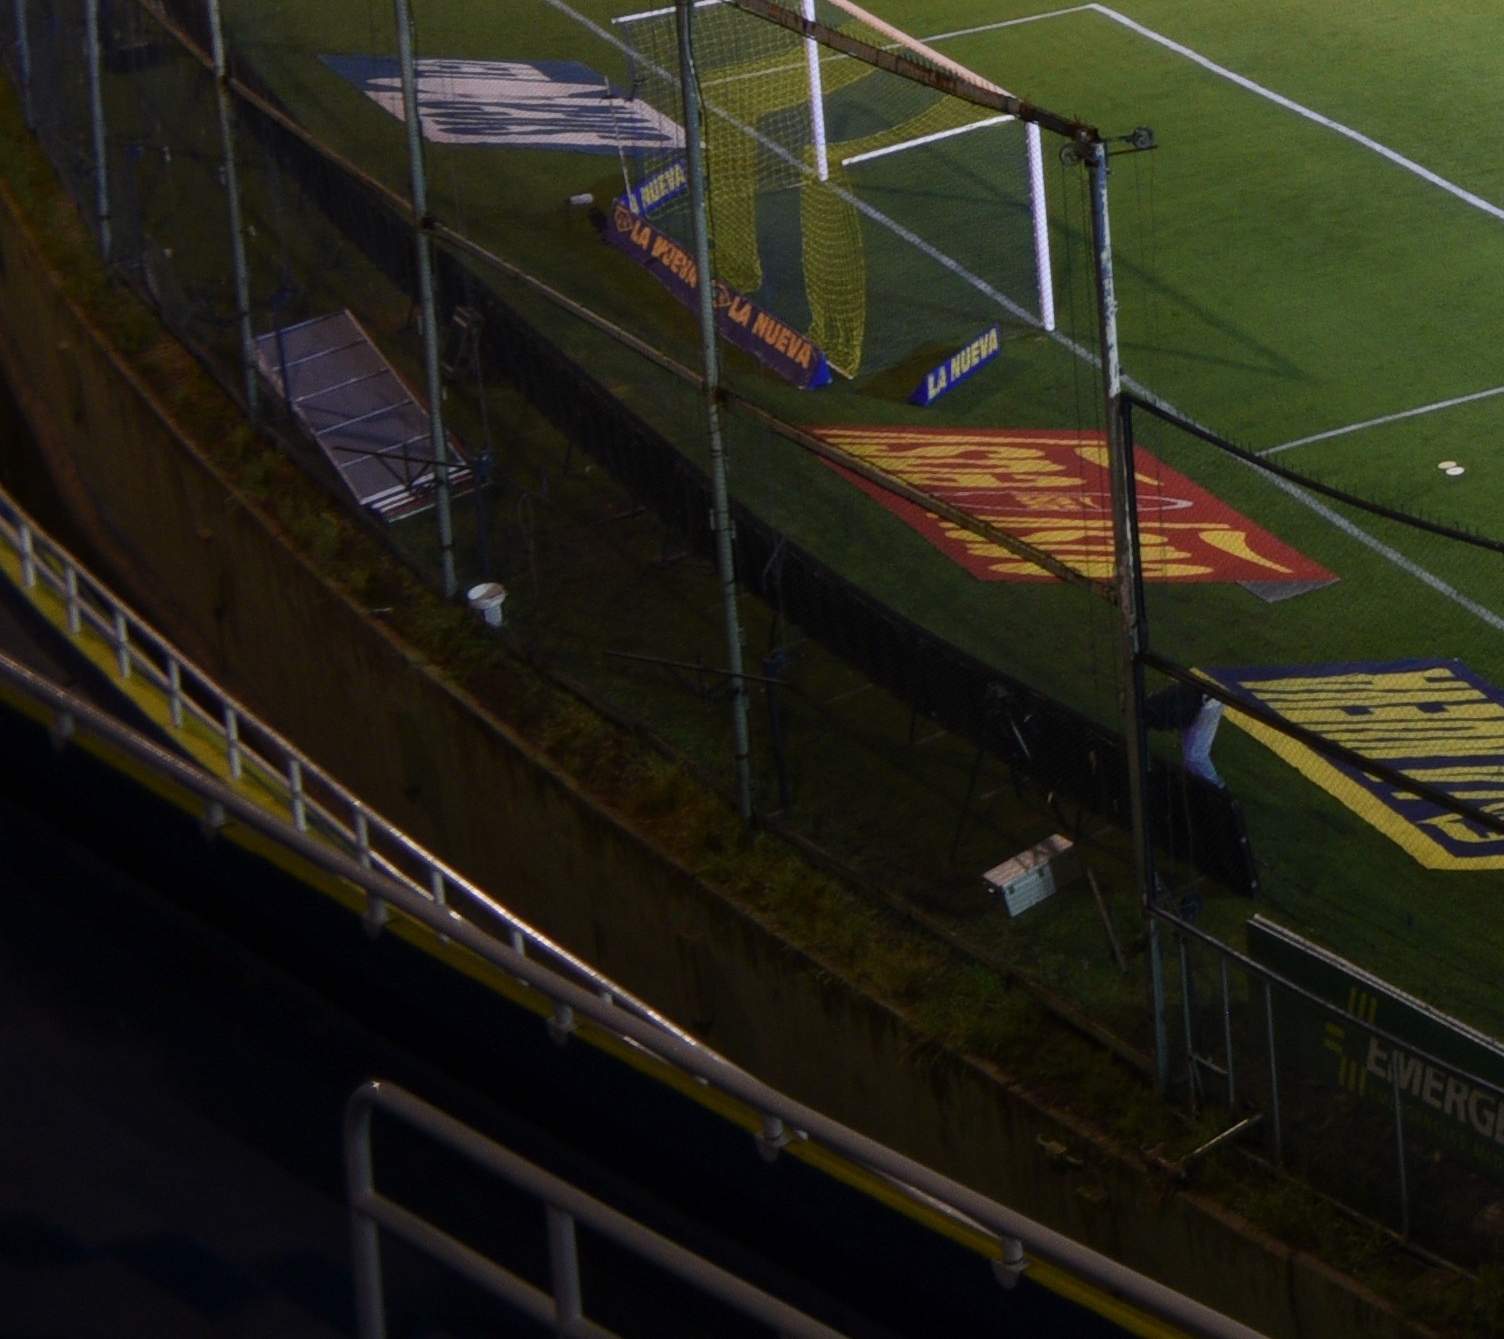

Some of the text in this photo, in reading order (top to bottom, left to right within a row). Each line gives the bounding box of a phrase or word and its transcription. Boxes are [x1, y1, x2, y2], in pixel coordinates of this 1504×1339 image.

[631, 218, 652, 250] LA
[729, 295, 813, 369] LA NUEVA
[927, 326, 999, 401] LA NUEVA
